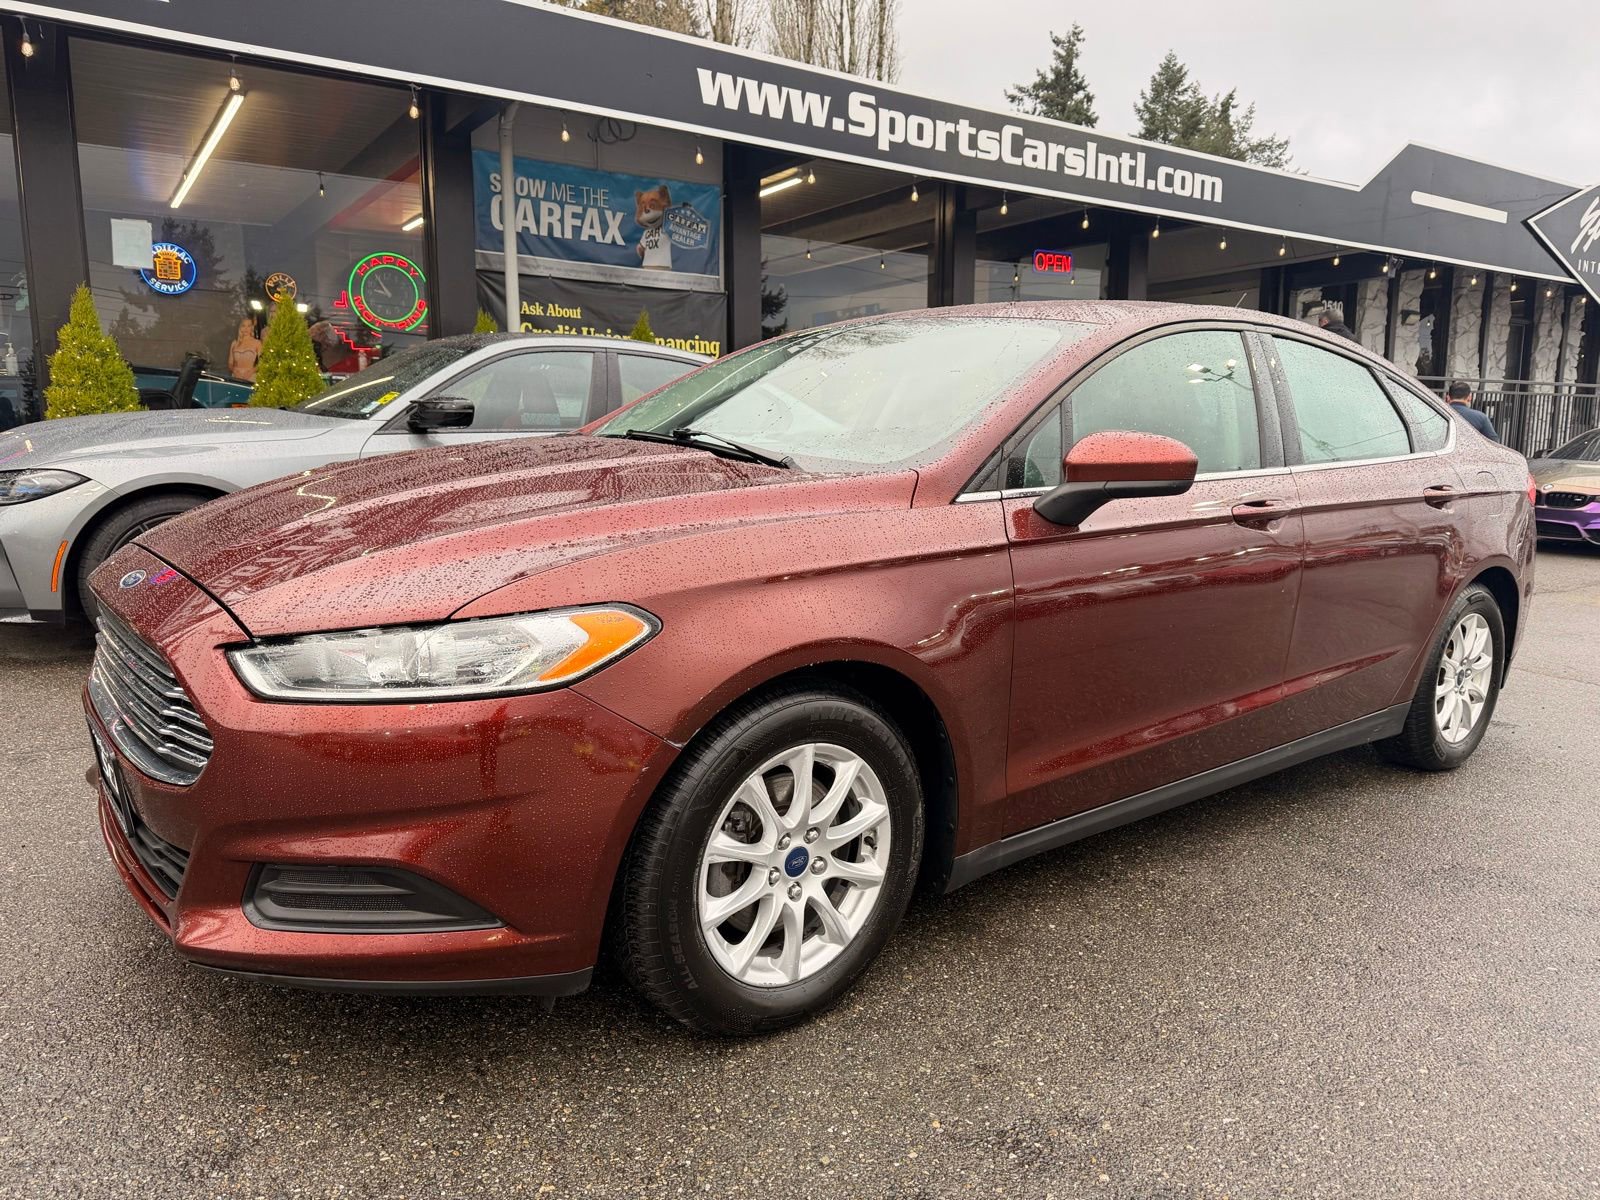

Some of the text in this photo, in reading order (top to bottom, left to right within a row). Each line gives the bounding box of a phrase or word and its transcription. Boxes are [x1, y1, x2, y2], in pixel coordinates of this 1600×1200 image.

[697, 68, 1223, 203] www.SportsCarsIntl.com
[489, 172, 609, 208] SOW ME THE
[490, 194, 626, 246] CARFAX
[668, 213, 706, 233] CARFAX
[645, 239, 660, 249] FOX
[671, 233, 695, 246] DEALER
[152, 244, 192, 264] DILLAC
[1035, 252, 1072, 273] OPEN
[357, 256, 419, 276] HAPPY
[149, 277, 189, 292] SERVICE
[354, 295, 426, 329] MOTORING
[520, 301, 581, 319] Ask About
[649, 331, 720, 360] nancing
